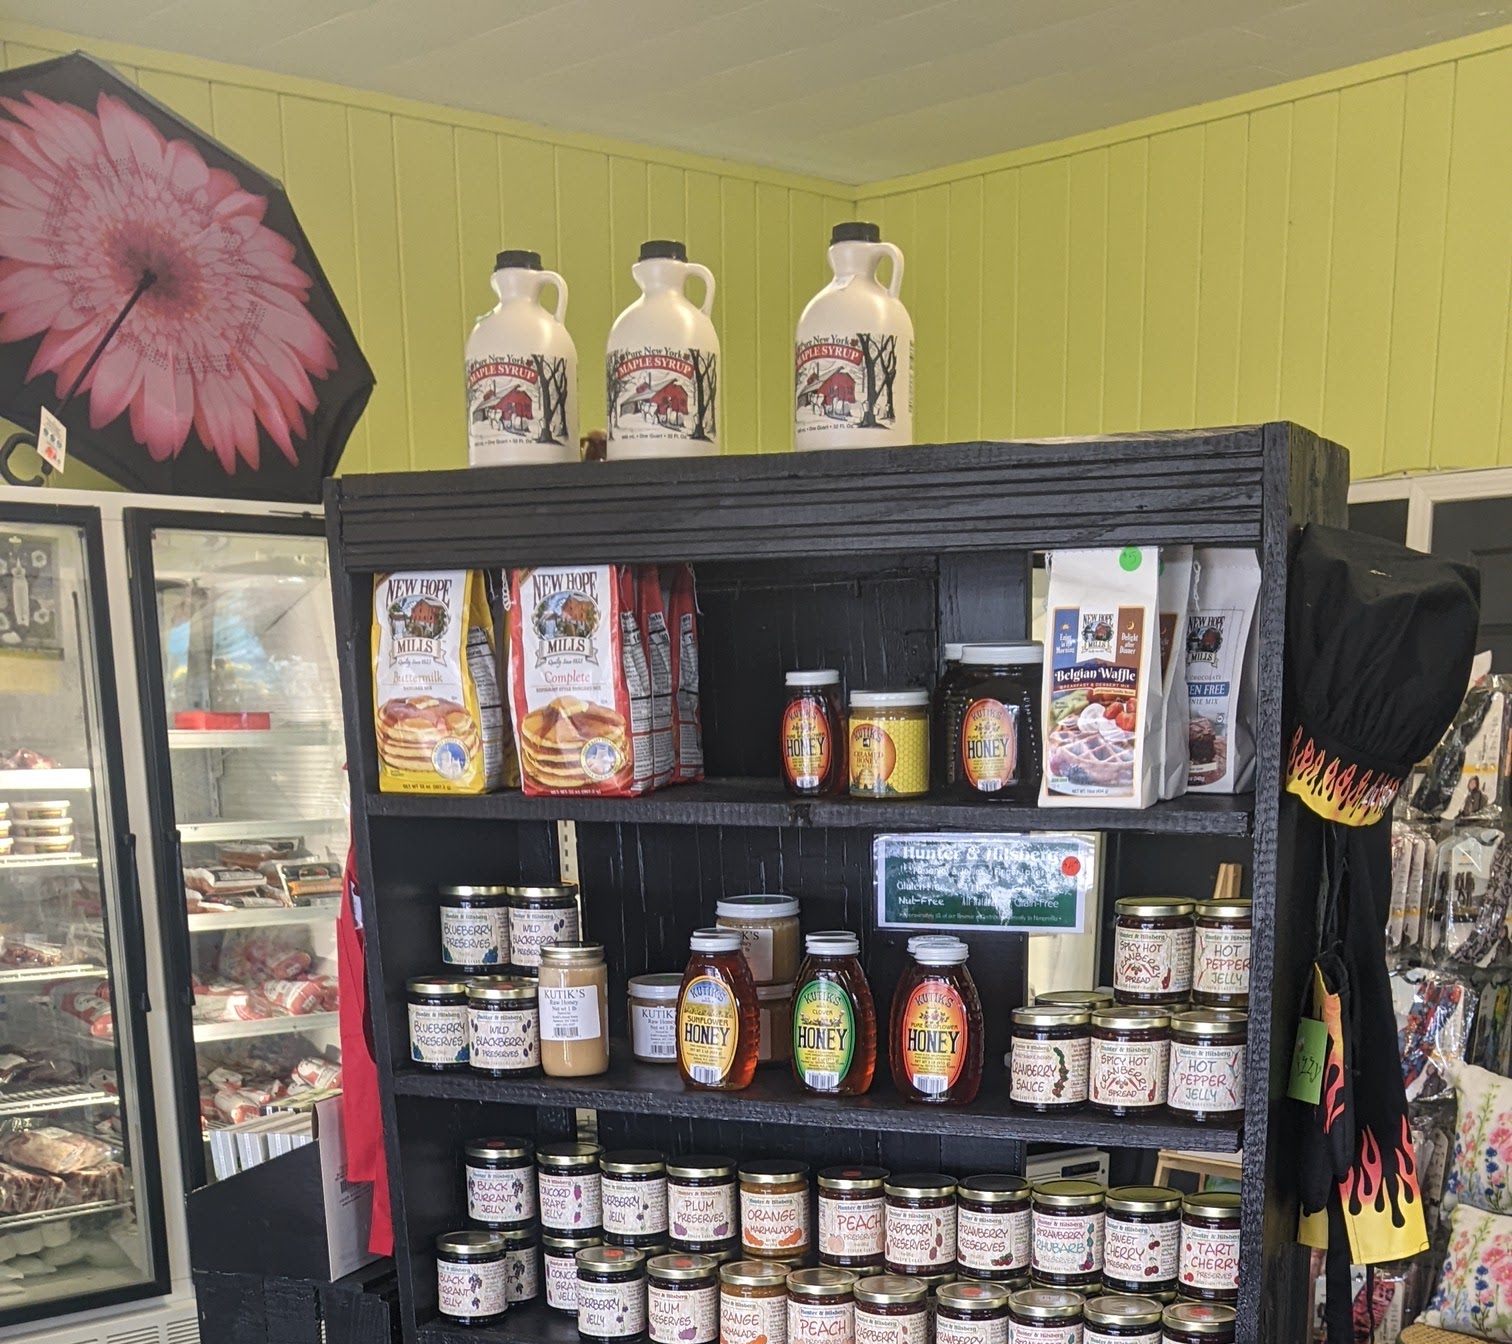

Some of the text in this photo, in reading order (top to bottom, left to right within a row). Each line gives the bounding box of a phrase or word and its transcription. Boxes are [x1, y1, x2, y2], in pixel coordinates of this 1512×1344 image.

[813, 335, 851, 345] New York
[643, 347, 683, 358] New York
[822, 346, 859, 361] SYRUP
[488, 354, 526, 365] New York
[619, 356, 692, 375] MAPLE SYRUP
[498, 363, 536, 382] SYRUP
[386, 578, 452, 607] NEW HOPE
[532, 572, 598, 606] NEW HOPE
[397, 640, 433, 654] MILLS
[548, 639, 586, 653] MILLS
[1191, 652, 1213, 661] MILLS
[393, 670, 443, 684] Buttermilk
[545, 670, 590, 686] Complete
[1055, 667, 1136, 682] Belgian Waffle
[1204, 684, 1226, 695] FREE
[787, 737, 825, 758] HONEY
[968, 739, 1009, 759] HONEY
[899, 895, 945, 906] Nut-Free
[444, 923, 493, 937] BLUEBERRY
[523, 924, 541, 933] WILD
[446, 937, 490, 949] PRESERVES
[1143, 944, 1162, 953] HOT
[1215, 945, 1242, 957] HOT
[1206, 959, 1251, 970] PEPPER
[1211, 973, 1243, 985] JELLY
[544, 989, 586, 999] KUTIK'S
[691, 986, 726, 1002] KUTIK'S
[804, 992, 841, 1006] KUTIK'S
[915, 993, 954, 1007] KUTIK'S
[688, 1015, 729, 1026] SUNFLOWER
[414, 1021, 466, 1034] BLUEBERRY
[490, 1026, 509, 1034] WILD
[685, 1023, 730, 1046] HONEY
[798, 1026, 847, 1051] HONEY
[417, 1035, 464, 1047] PRESERVES
[475, 1036, 525, 1047] BLACKBERRY
[907, 1028, 960, 1054] HONEY
[1101, 1055, 1148, 1066] SPICY HOT
[1189, 1061, 1216, 1073] HOT
[1016, 1079, 1044, 1092] SAUCE
[1180, 1074, 1226, 1086] PEPPER
[1108, 1089, 1137, 1097] SPREAD
[1186, 1089, 1216, 1101] JELLY
[477, 1182, 508, 1191] BLACK
[481, 1205, 505, 1214] JELLY
[685, 1200, 714, 1211] PLUM
[677, 1212, 724, 1224] PRESERVES
[748, 1209, 796, 1221] ORANGE
[837, 1215, 882, 1230] PEACH
[749, 1225, 794, 1234] MARMALADE
[888, 1223, 933, 1237] RASPBERRY
[959, 1223, 1008, 1238] STRAWBERRY
[1037, 1230, 1085, 1240] STRAWBERRY
[890, 1238, 930, 1250] PRESERVES
[1111, 1233, 1136, 1245] SWEET
[960, 1240, 1005, 1252] PRESERVES
[1036, 1240, 1086, 1253] RHUBARB
[1198, 1243, 1234, 1256] TART
[1106, 1244, 1145, 1261] CHERRY
[1191, 1257, 1239, 1270] CHERRY
[654, 1303, 679, 1313] PLUM
[800, 1320, 846, 1335] PEACH
